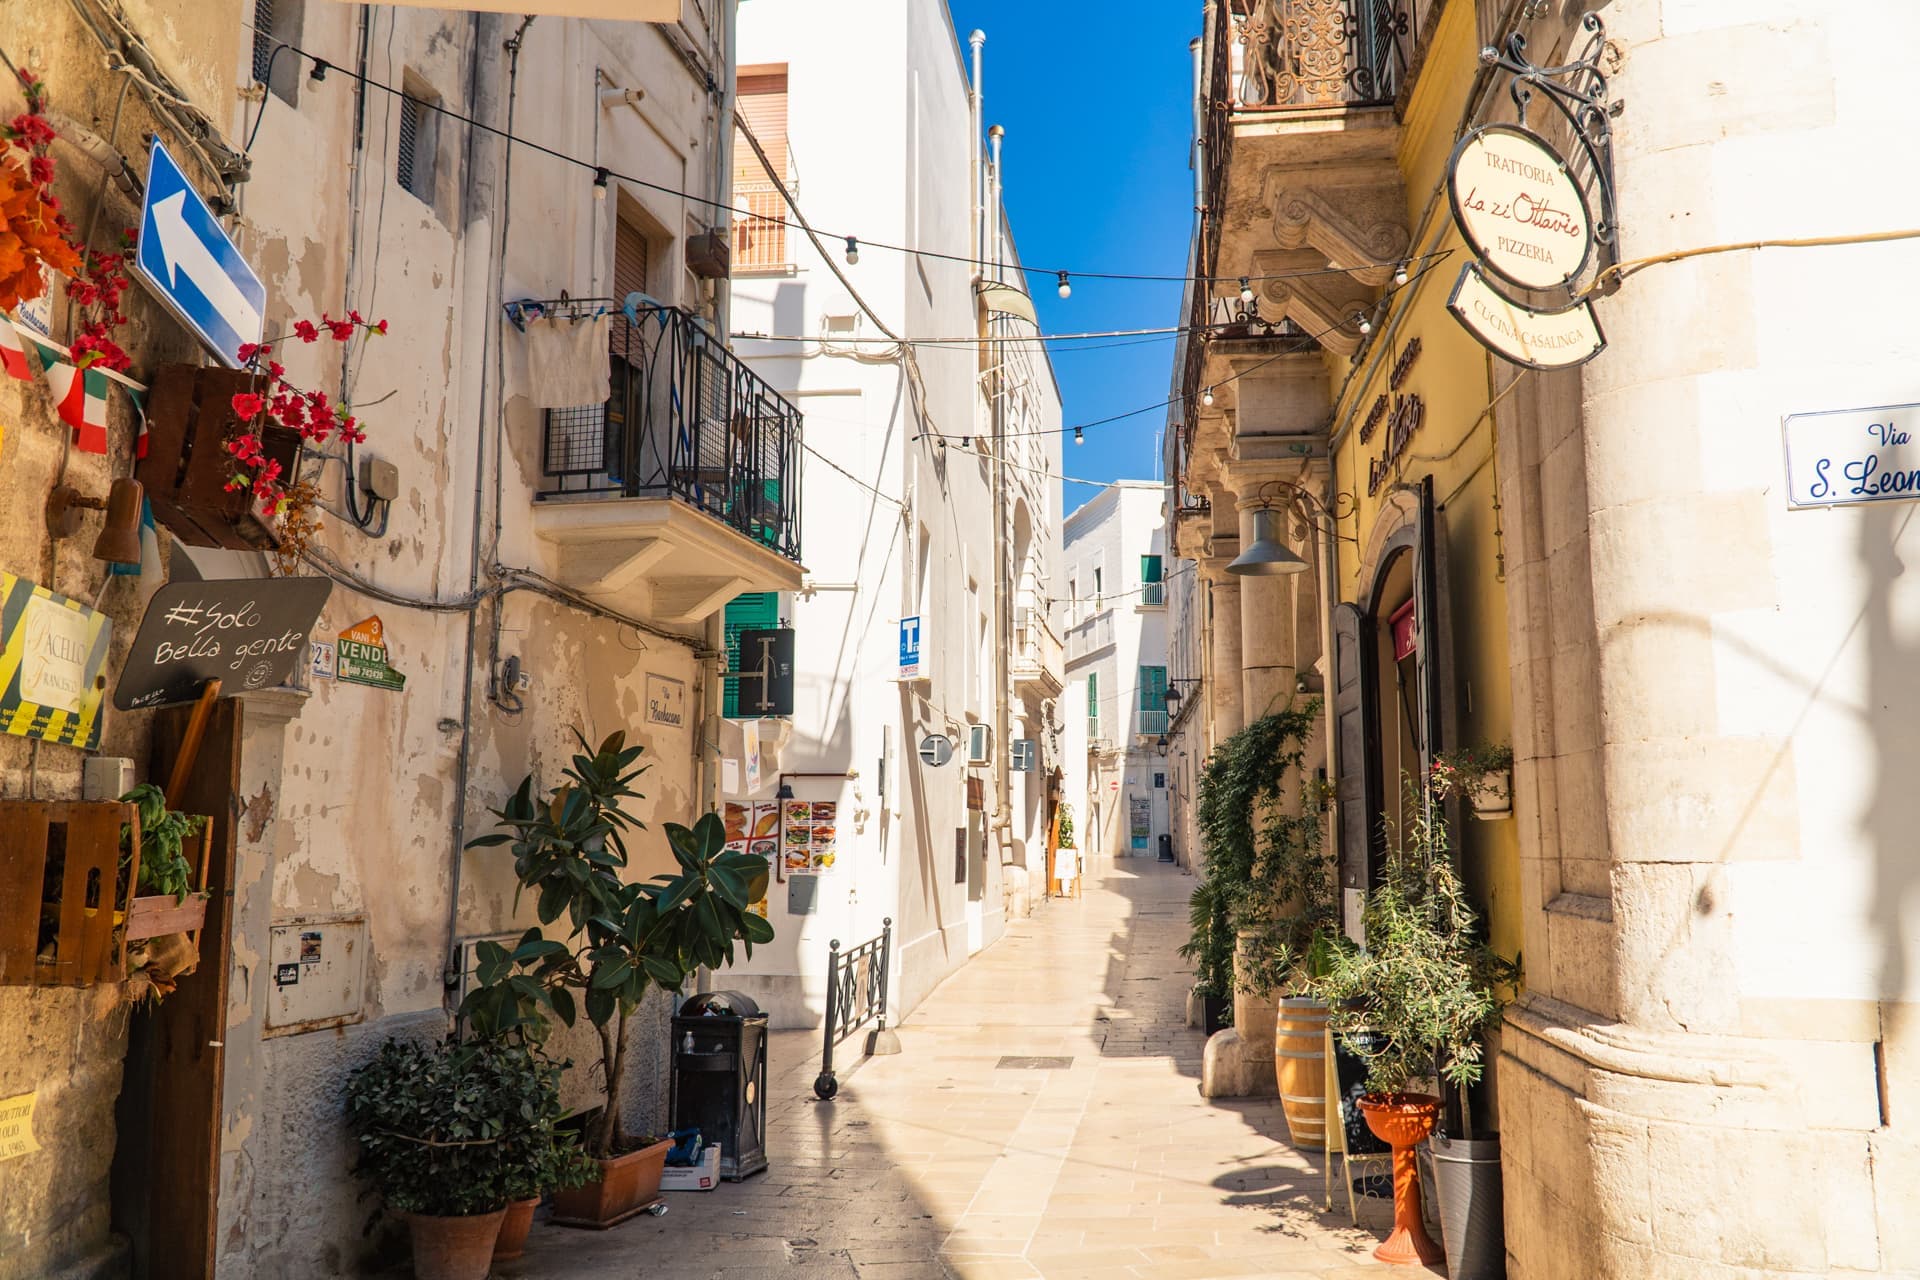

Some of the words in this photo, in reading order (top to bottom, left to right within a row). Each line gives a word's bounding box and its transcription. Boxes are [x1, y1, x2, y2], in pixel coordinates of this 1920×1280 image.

[1484, 151, 1555, 186] TRATTORIA
[1513, 192, 1580, 238] Ottavio
[1497, 236, 1554, 265] PIZZERIA
[1473, 299, 1519, 344] CUCINA
[1521, 327, 1585, 350] CASALINGA
[1868, 421, 1911, 447] Via
[1810, 458, 1837, 498] S.
[351, 630, 369, 643] VANI
[371, 621, 379, 634] 3
[154, 635, 220, 665] Bella
[230, 629, 302, 670] gente
